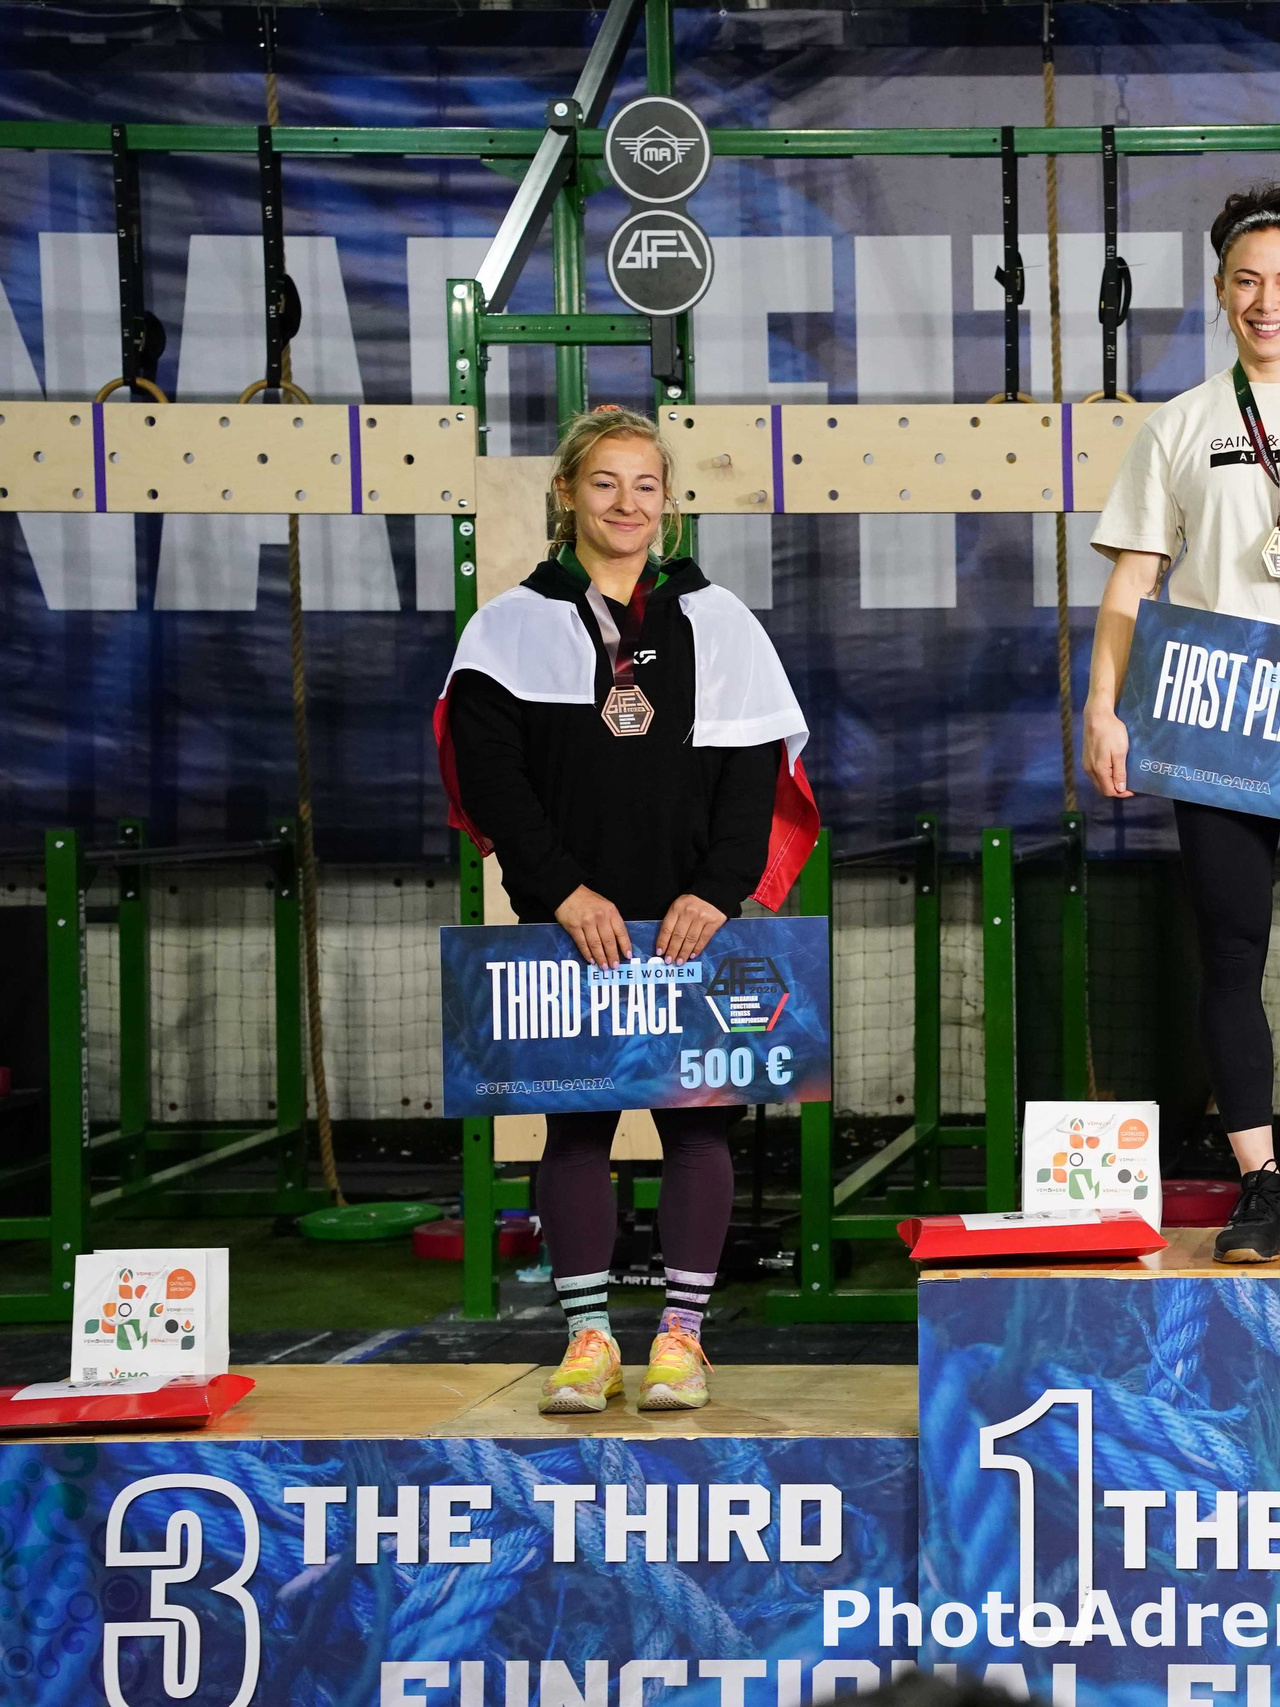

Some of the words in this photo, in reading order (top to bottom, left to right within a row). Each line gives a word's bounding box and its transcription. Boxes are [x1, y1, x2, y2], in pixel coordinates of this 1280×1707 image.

[643, 147, 671, 162] MA
[1153, 641, 1248, 732] FIRST
[1140, 759, 1192, 781] SOFIA,
[1193, 769, 1272, 795] BULGARIA
[486, 960, 582, 1041] THIRD
[590, 957, 683, 1037] PLACE
[592, 970, 634, 980] ELITE
[642, 968, 695, 978] WOMEN
[476, 1081, 530, 1096] SOFIA,
[532, 1078, 615, 1093] BULGARIA
[680, 1046, 755, 1089] 500
[766, 1045, 794, 1086] €
[284, 1484, 493, 1565] THE
[534, 1483, 843, 1564] THIRD
[979, 1388, 1094, 1643] 1
[104, 1474, 260, 1707] 3
